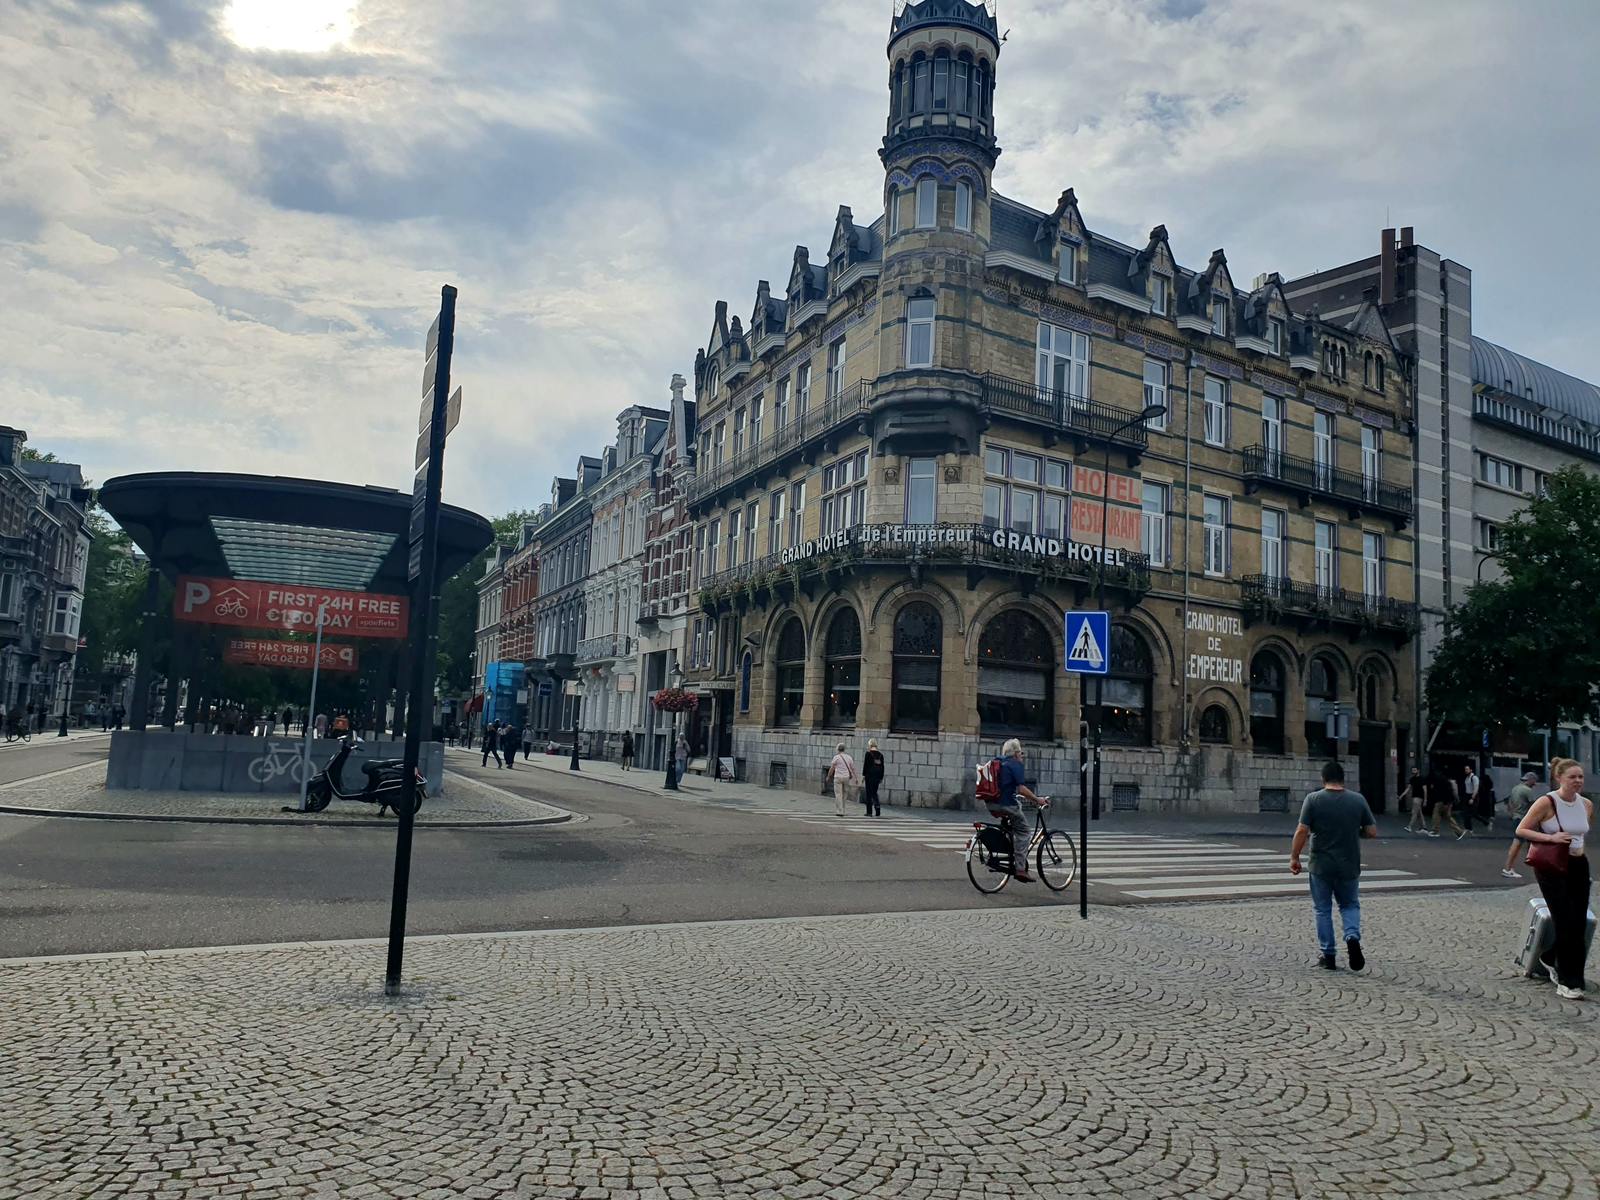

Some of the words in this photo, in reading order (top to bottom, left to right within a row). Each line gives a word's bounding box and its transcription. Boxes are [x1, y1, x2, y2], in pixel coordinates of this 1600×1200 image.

[1074, 466, 1140, 503] HOTEL
[1072, 500, 1141, 541] RESTAURANT
[781, 542, 812, 564] GRAND
[816, 529, 849, 554] HOTEL
[862, 525, 880, 542] de
[885, 525, 974, 545] l'Empereur
[992, 529, 1060, 556] GRAND
[1067, 542, 1124, 567] HOTEL
[184, 582, 211, 613] P
[268, 590, 316, 608] FIRST
[321, 596, 353, 611] 24H
[358, 599, 400, 615] FREE
[1186, 611, 1214, 632] GRAND
[1216, 616, 1243, 636] HOTEL
[1207, 637, 1221, 651] DE
